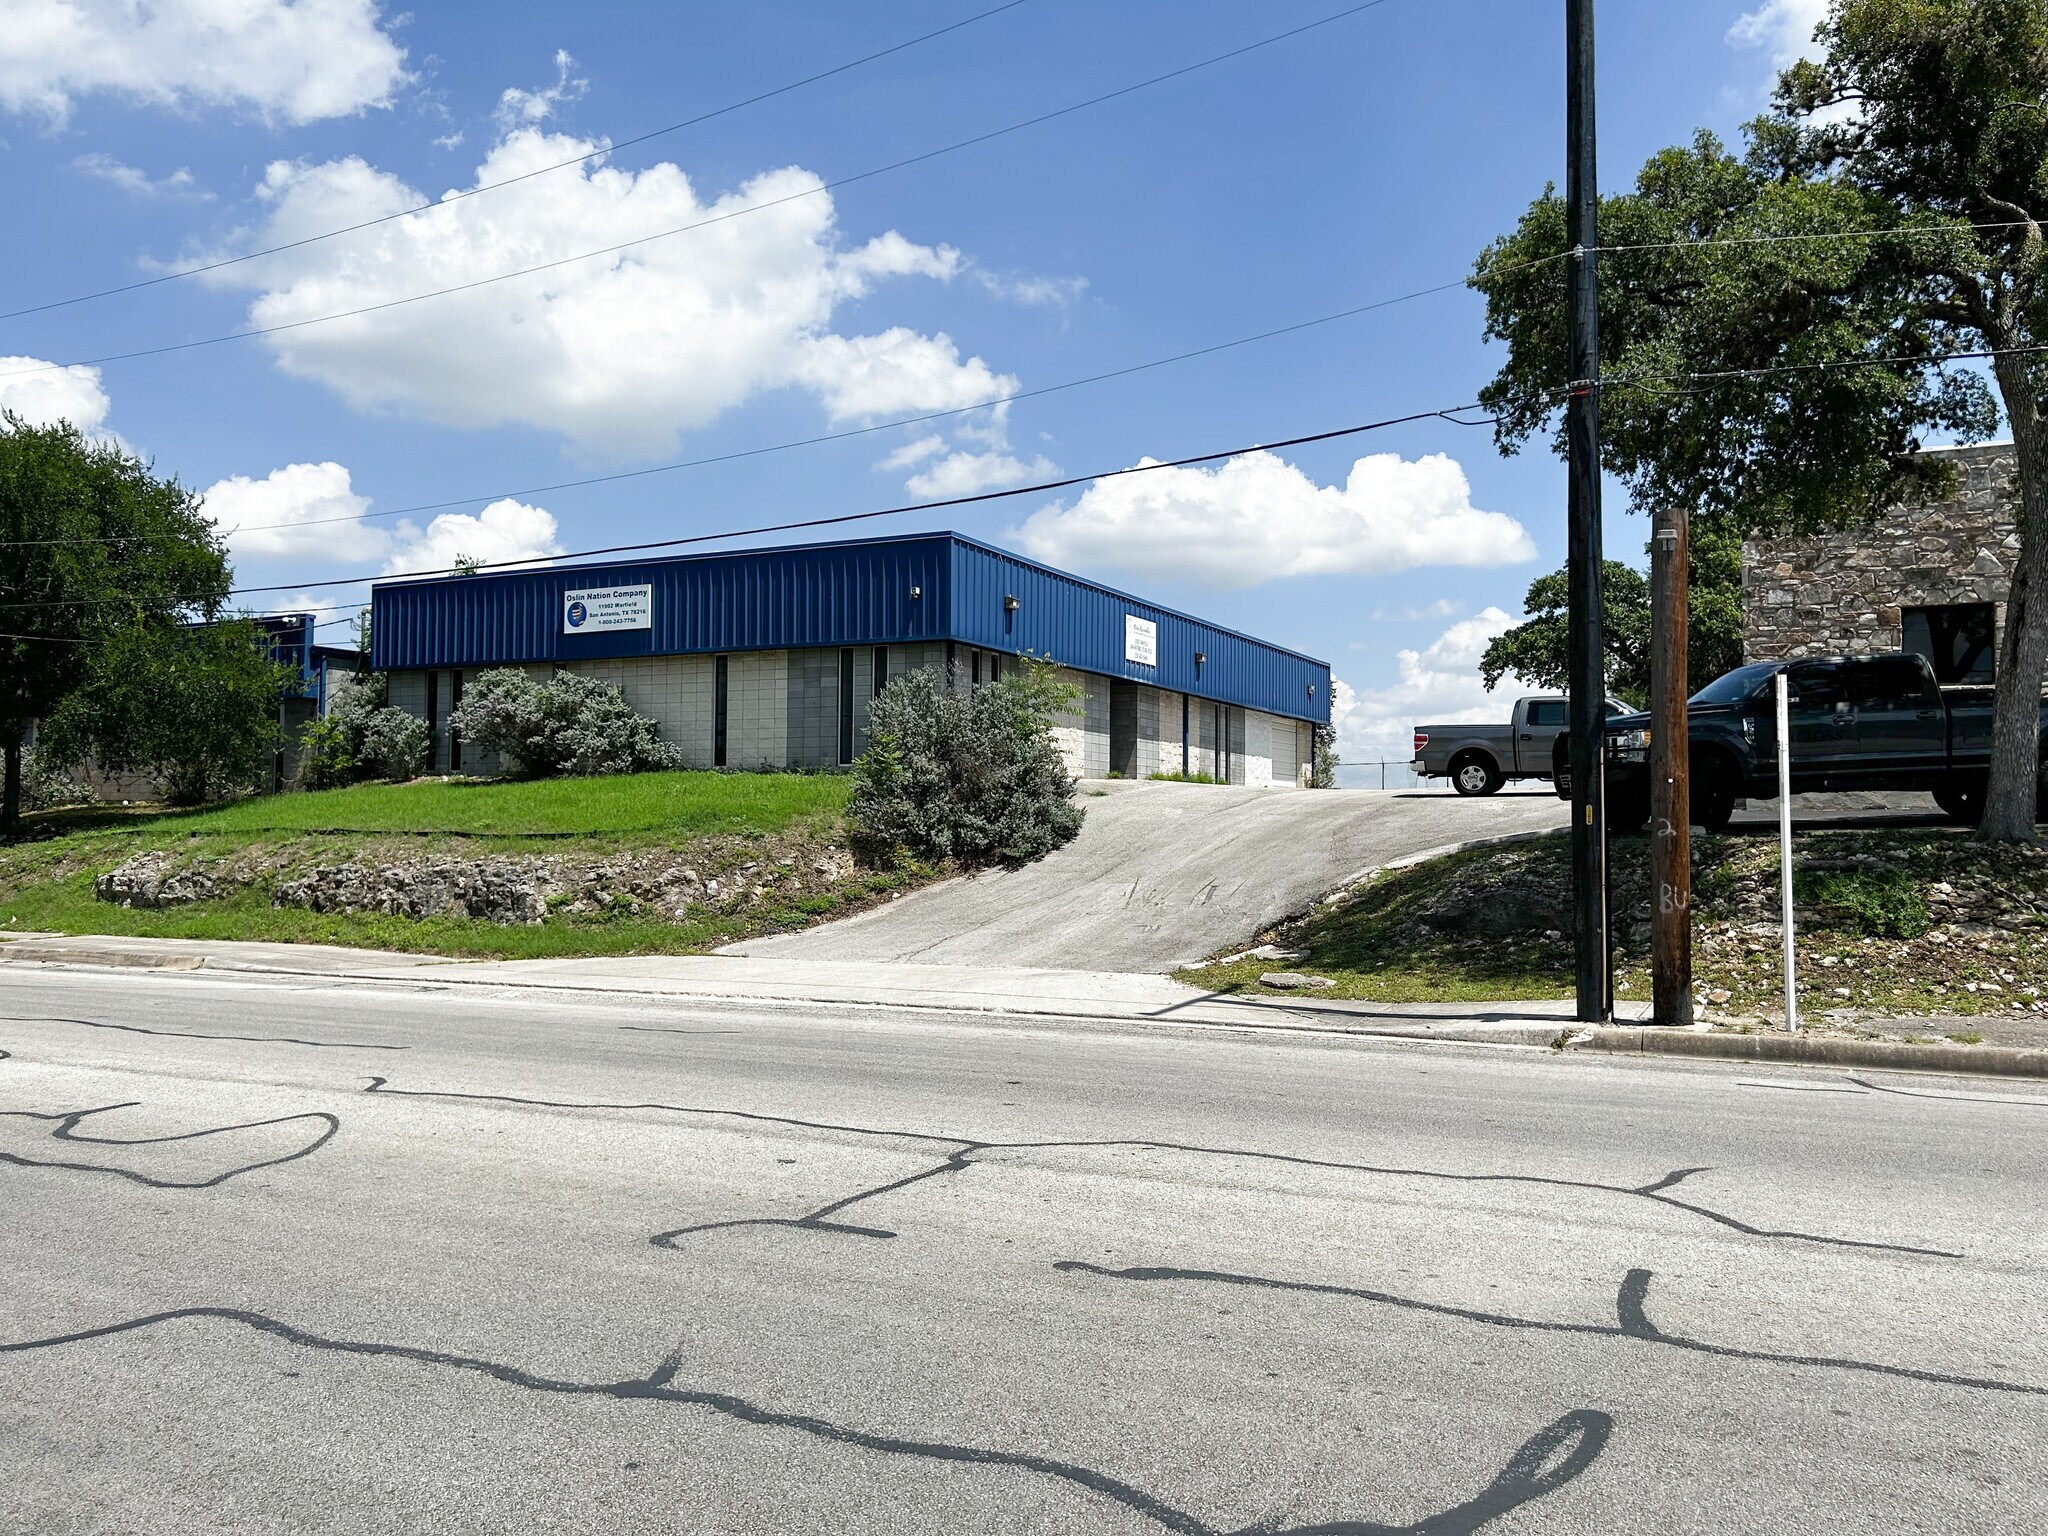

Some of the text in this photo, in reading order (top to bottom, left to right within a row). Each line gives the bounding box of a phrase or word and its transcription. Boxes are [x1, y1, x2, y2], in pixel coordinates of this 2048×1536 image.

[566, 589, 648, 602] Oslin Nation Company
